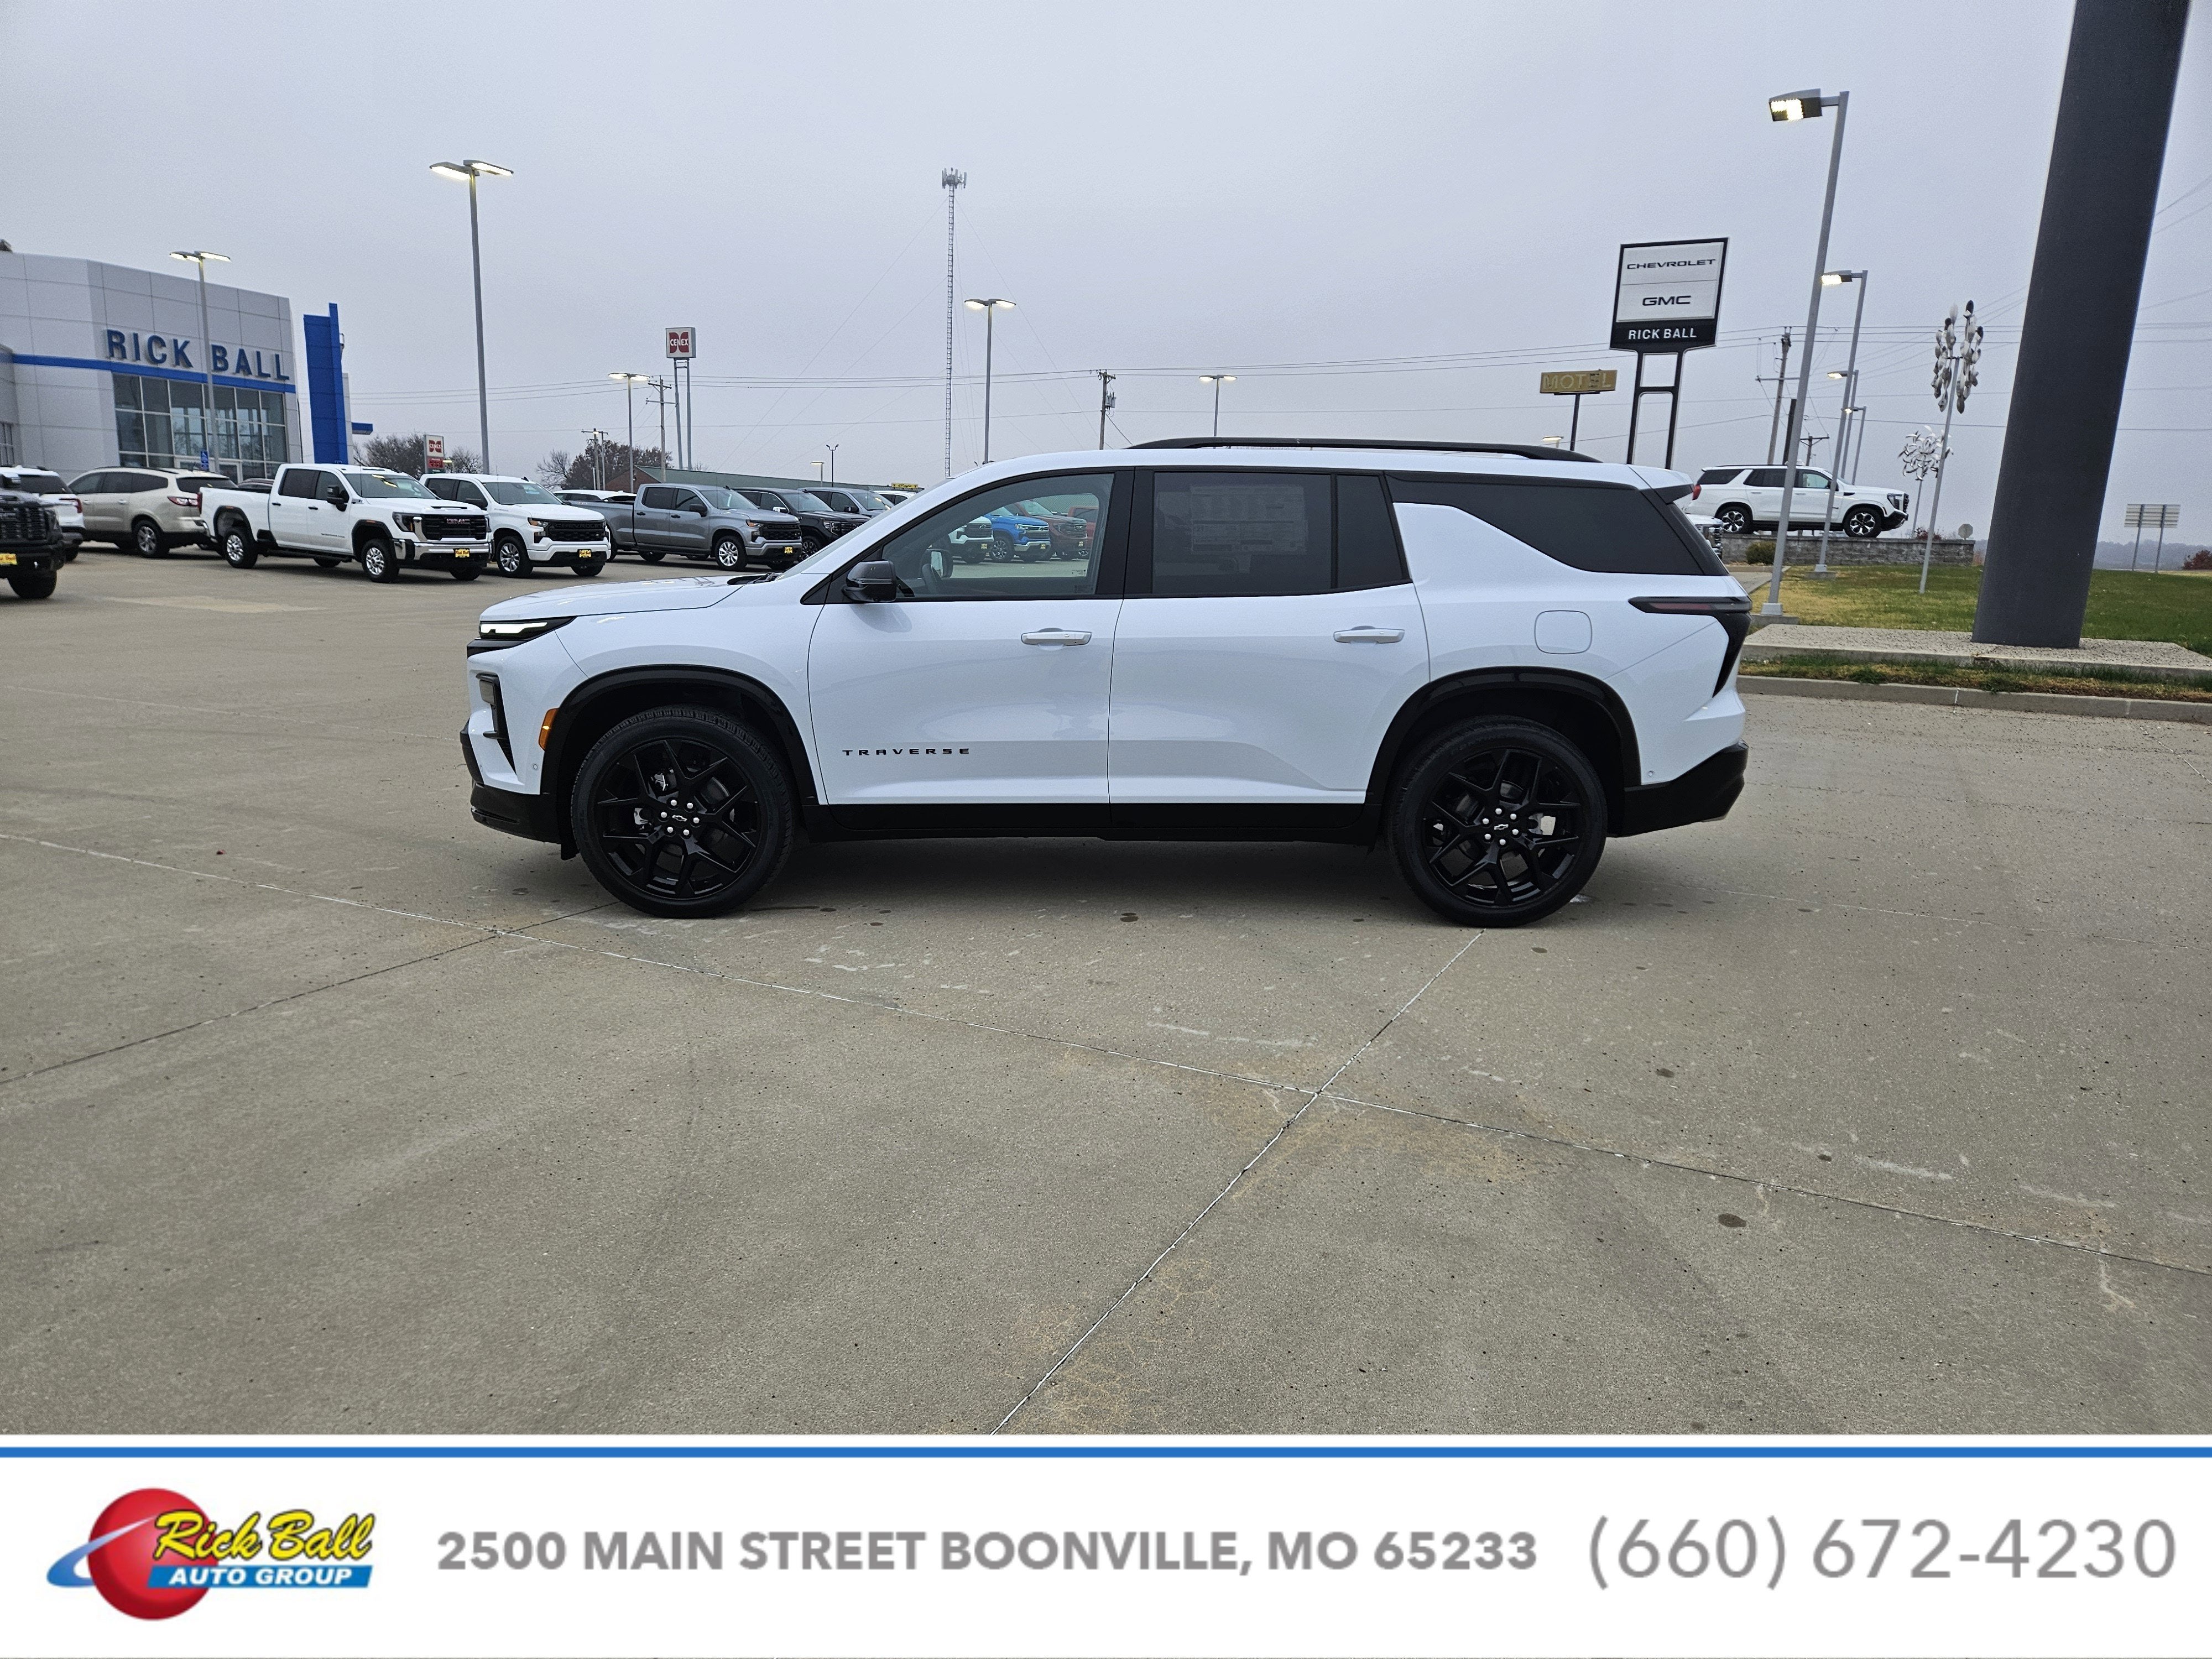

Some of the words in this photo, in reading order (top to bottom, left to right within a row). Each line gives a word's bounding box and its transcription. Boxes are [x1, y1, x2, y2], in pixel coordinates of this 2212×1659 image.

[1627, 259, 1716, 269] CHEVROLET
[1642, 295, 1691, 306] GMC
[1628, 328, 1660, 340] RICK
[1663, 327, 1697, 338] BALL
[670, 338, 688, 346] CENEX
[107, 329, 194, 368] RICK
[211, 343, 290, 380] BALL
[1542, 372, 1612, 389] MOTEL
[842, 748, 969, 756] TRAVERSE
